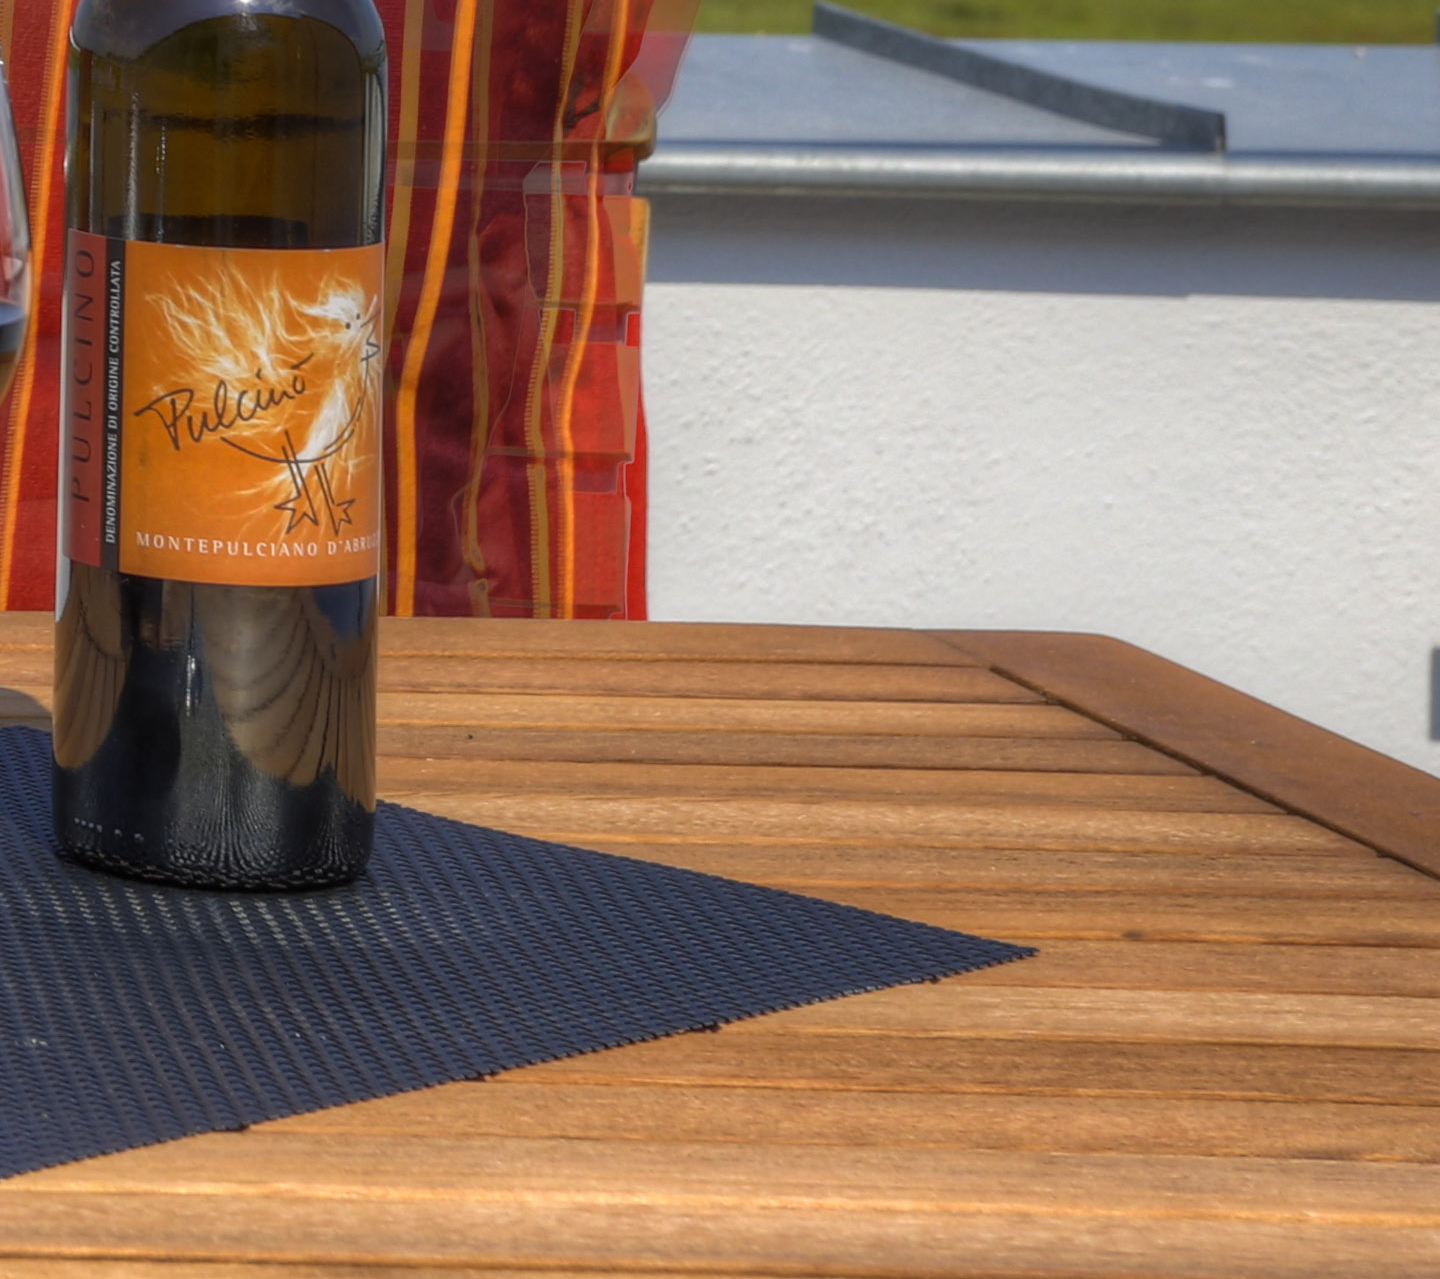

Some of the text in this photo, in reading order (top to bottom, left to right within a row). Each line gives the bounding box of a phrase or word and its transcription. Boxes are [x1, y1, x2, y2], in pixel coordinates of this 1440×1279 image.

[72, 250, 94, 503] PULCINO
[105, 259, 121, 544] DENOMINAZIONE DI ORIGINE CONTROLLATA
[136, 531, 318, 557] MONTEPULCIANO
